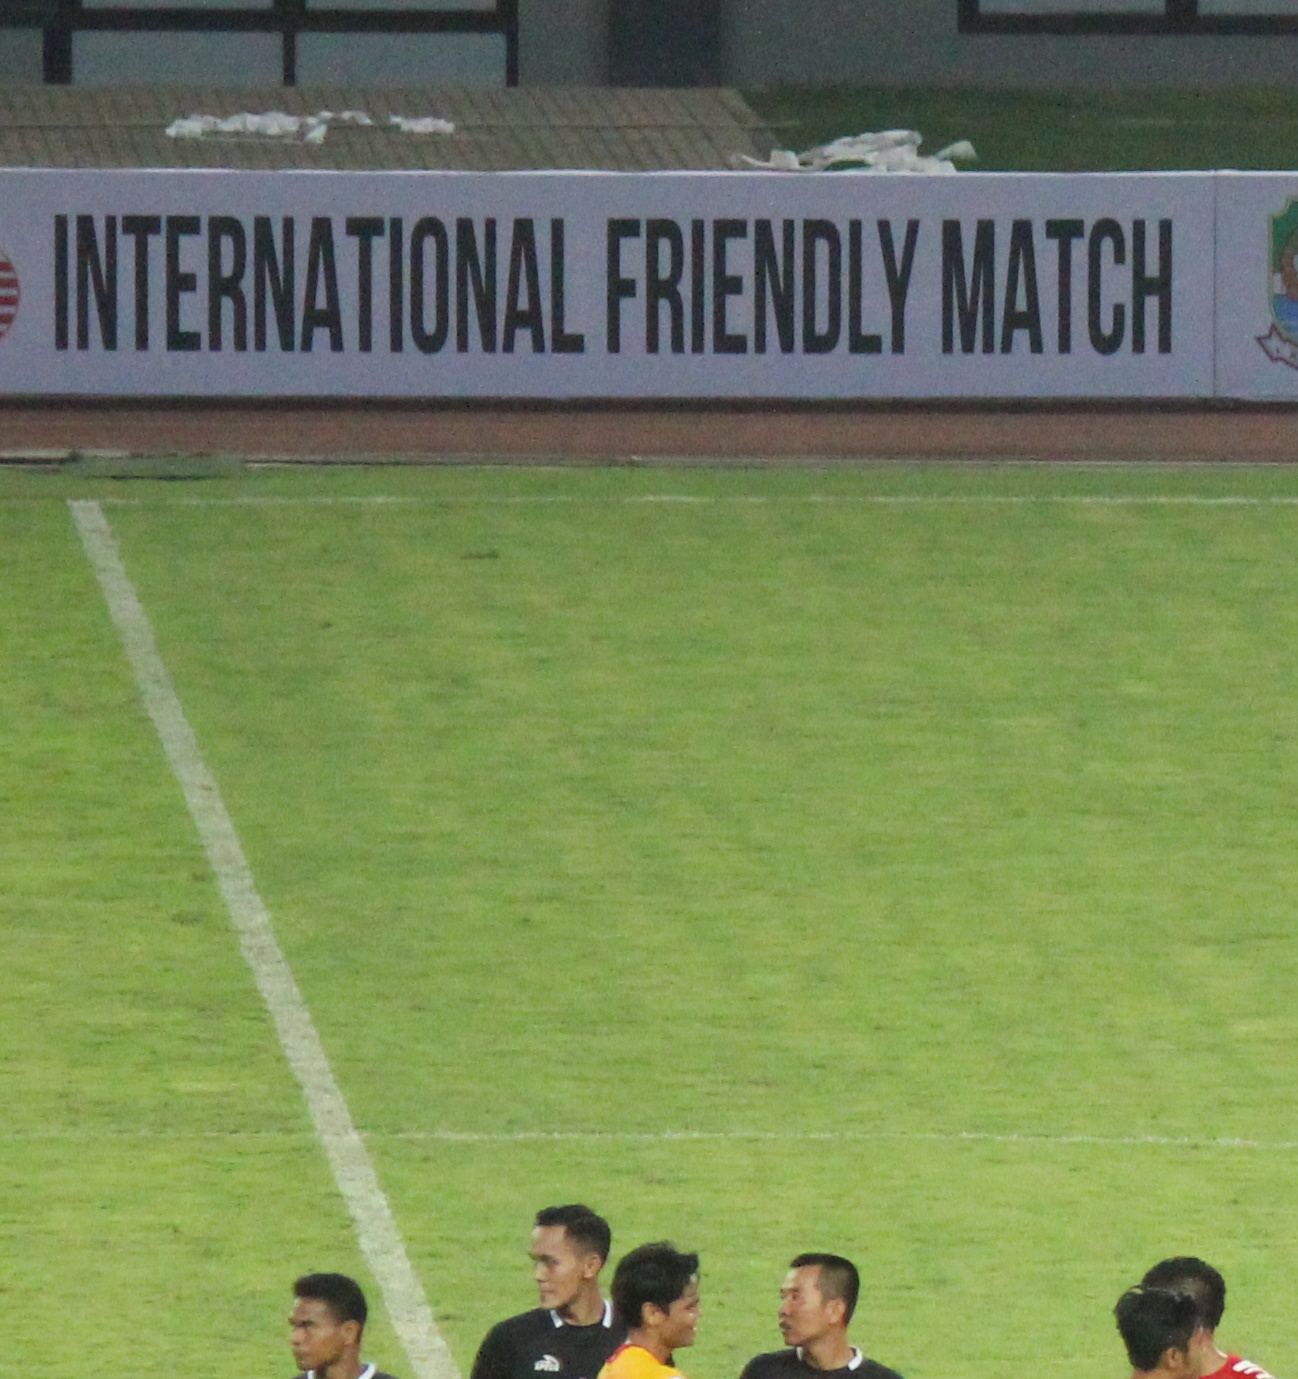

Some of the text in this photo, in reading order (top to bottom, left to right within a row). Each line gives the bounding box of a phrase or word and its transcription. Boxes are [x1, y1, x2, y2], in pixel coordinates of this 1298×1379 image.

[54, 214, 1173, 356] INTERNATIONAL FRIENDLY MATCH
